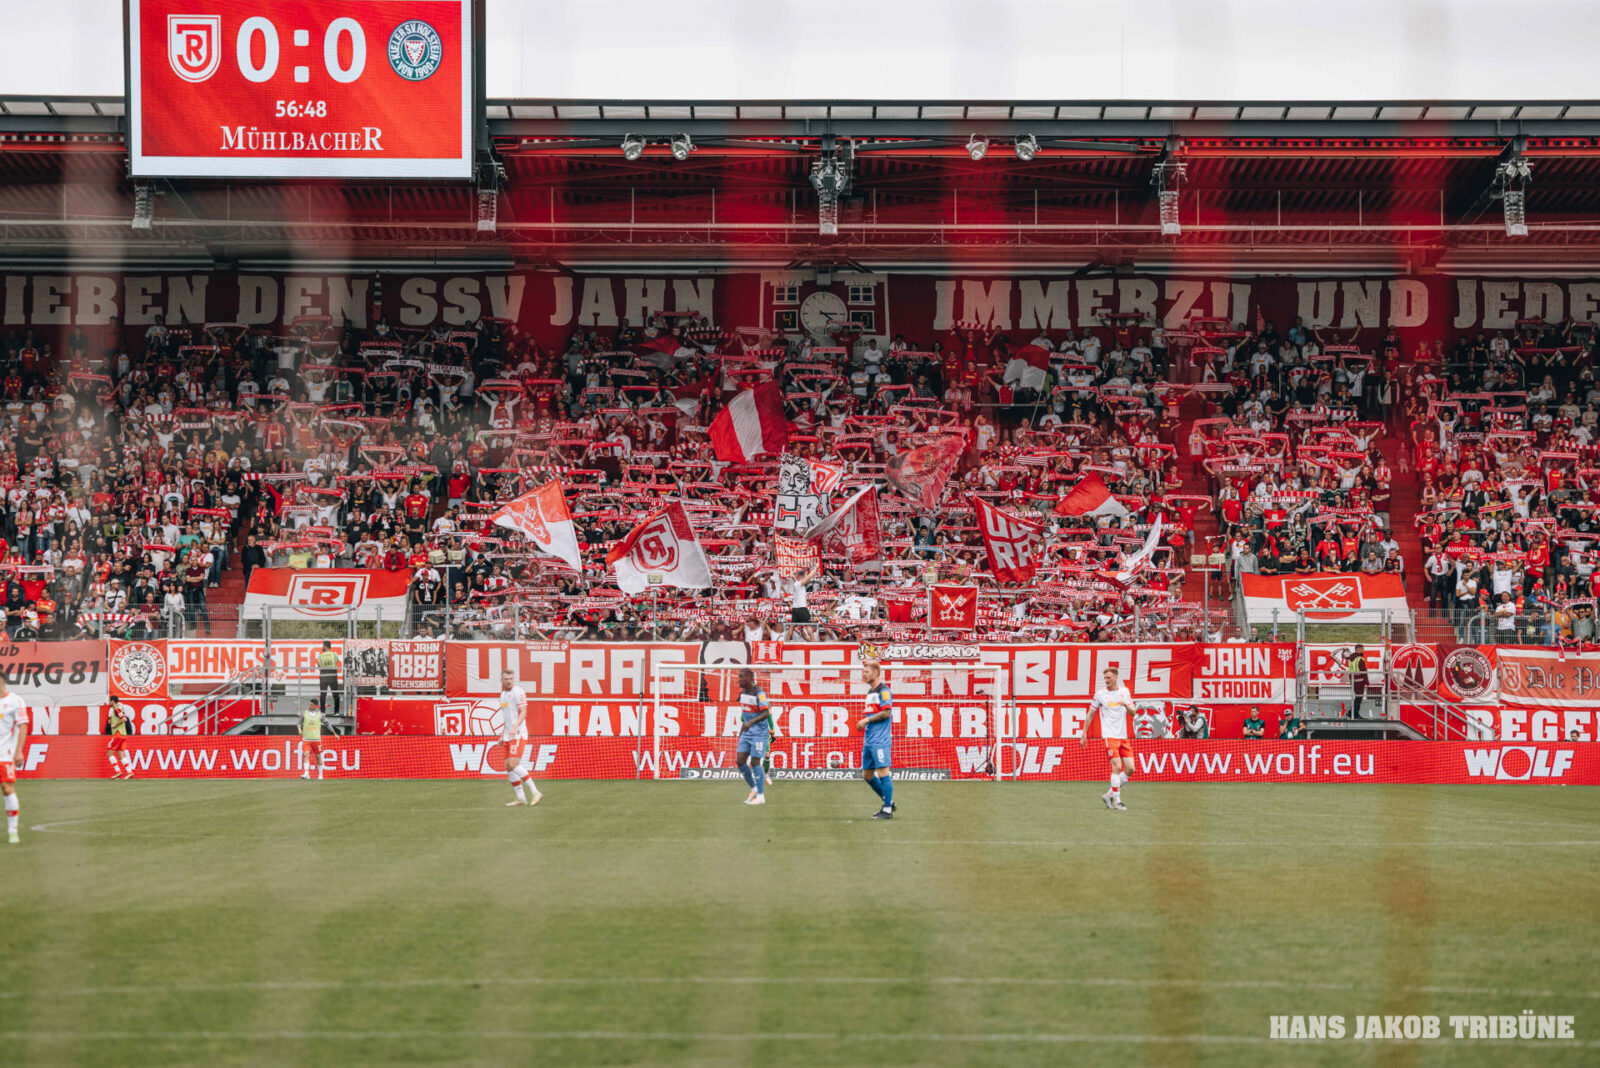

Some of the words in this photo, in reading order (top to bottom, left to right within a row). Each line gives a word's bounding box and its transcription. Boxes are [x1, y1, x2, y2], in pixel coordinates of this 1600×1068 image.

[236, 16, 367, 84] 0:0
[390, 29, 407, 61] KIELER
[404, 22, 417, 35] SV
[416, 23, 440, 61] HOLSTEIN
[397, 61, 414, 78] VON
[414, 61, 434, 78] 1900
[275, 100, 327, 118] 56:48
[220, 125, 384, 151] MÜHLBACHER
[237, 276, 369, 329] DEN
[400, 277, 526, 326] SSV
[550, 277, 715, 329] JAHN
[934, 279, 1251, 331] IMMERZU
[1297, 279, 1429, 329] UND
[1453, 279, 1600, 330] JEDE
[391, 642, 410, 652] SSV
[413, 642, 440, 652] JAHN
[884, 643, 911, 659] RED
[0, 662, 64, 688] URG
[69, 661, 99, 684] 81
[391, 654, 439, 678] 1889
[466, 647, 685, 695] ULTRAS
[1201, 647, 1271, 676] JAHN
[391, 679, 439, 689] REGENSBURG
[1201, 680, 1272, 698] STADION
[1525, 664, 1565, 689] Die
[552, 704, 680, 737] HANS
[1463, 709, 1600, 742] REGE
[631, 742, 864, 771] www.olf.eu
[1138, 744, 1375, 775] www.wolf.eu
[1464, 746, 1575, 780] WOLF
[775, 770, 855, 780] PANOMERA
